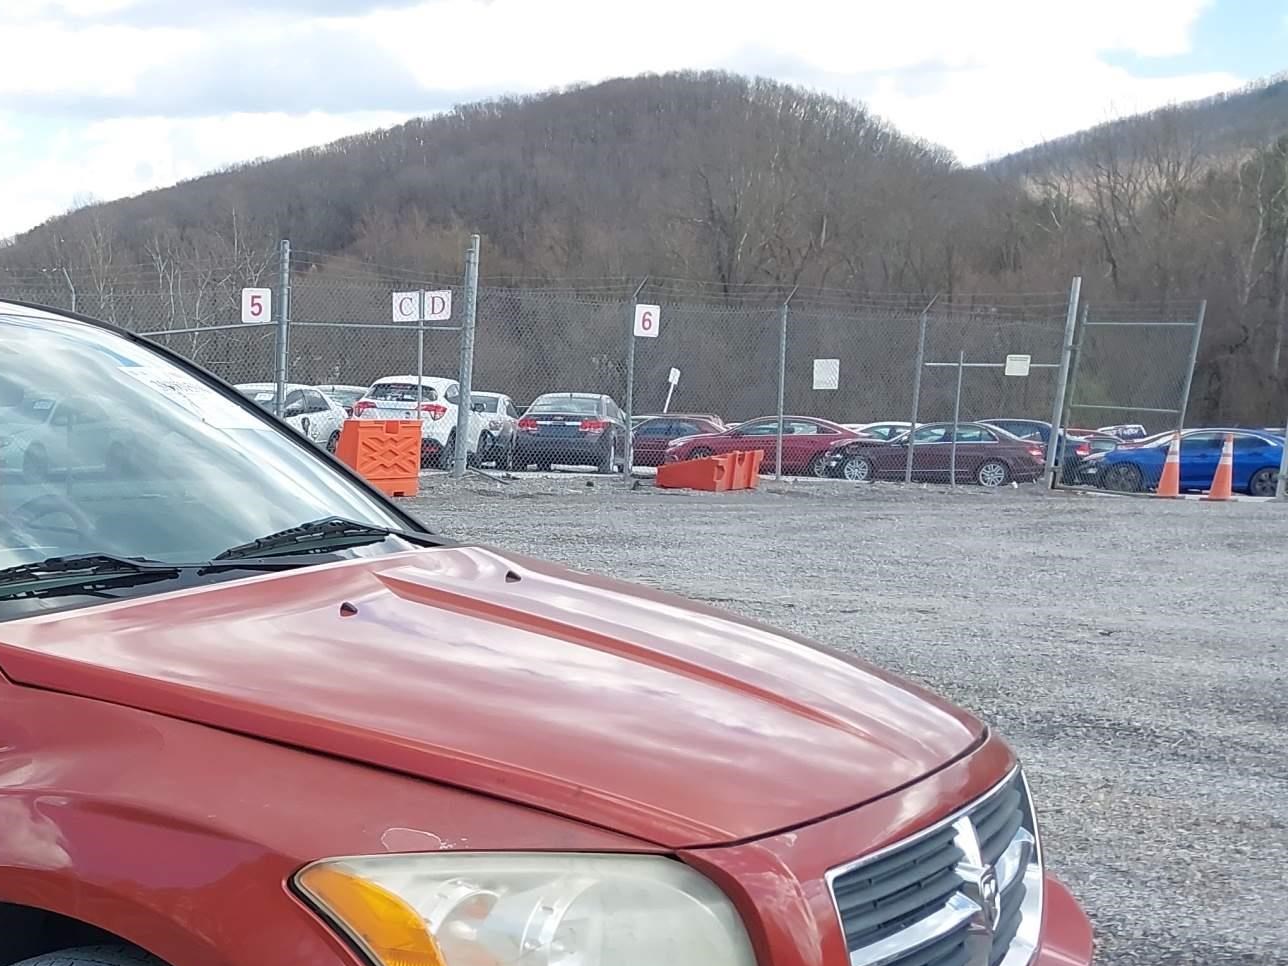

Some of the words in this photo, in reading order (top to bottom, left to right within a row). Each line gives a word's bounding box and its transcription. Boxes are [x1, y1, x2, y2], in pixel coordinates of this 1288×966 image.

[250, 294, 263, 317] 5
[399, 296, 414, 317] C
[430, 295, 446, 315] D
[642, 311, 652, 331] 6
